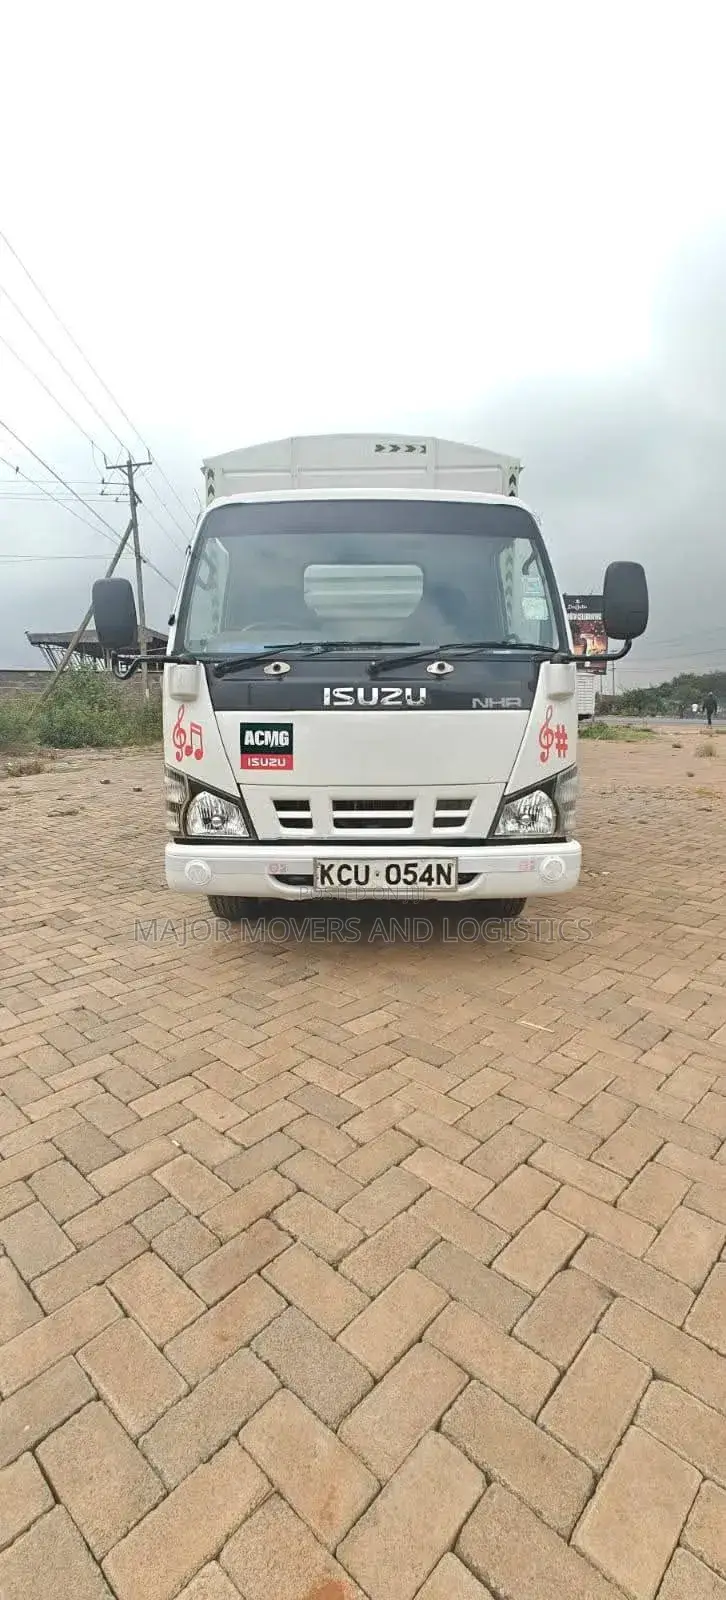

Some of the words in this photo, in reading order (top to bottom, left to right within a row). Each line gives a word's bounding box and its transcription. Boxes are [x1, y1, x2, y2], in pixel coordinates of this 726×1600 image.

[323, 687, 427, 706] ISUZU
[472, 697, 522, 709] NHR
[244, 729, 290, 748] ACMG
[247, 757, 286, 767] ISUZU
[320, 863, 370, 886] KCU
[385, 863, 452, 886] 054N
